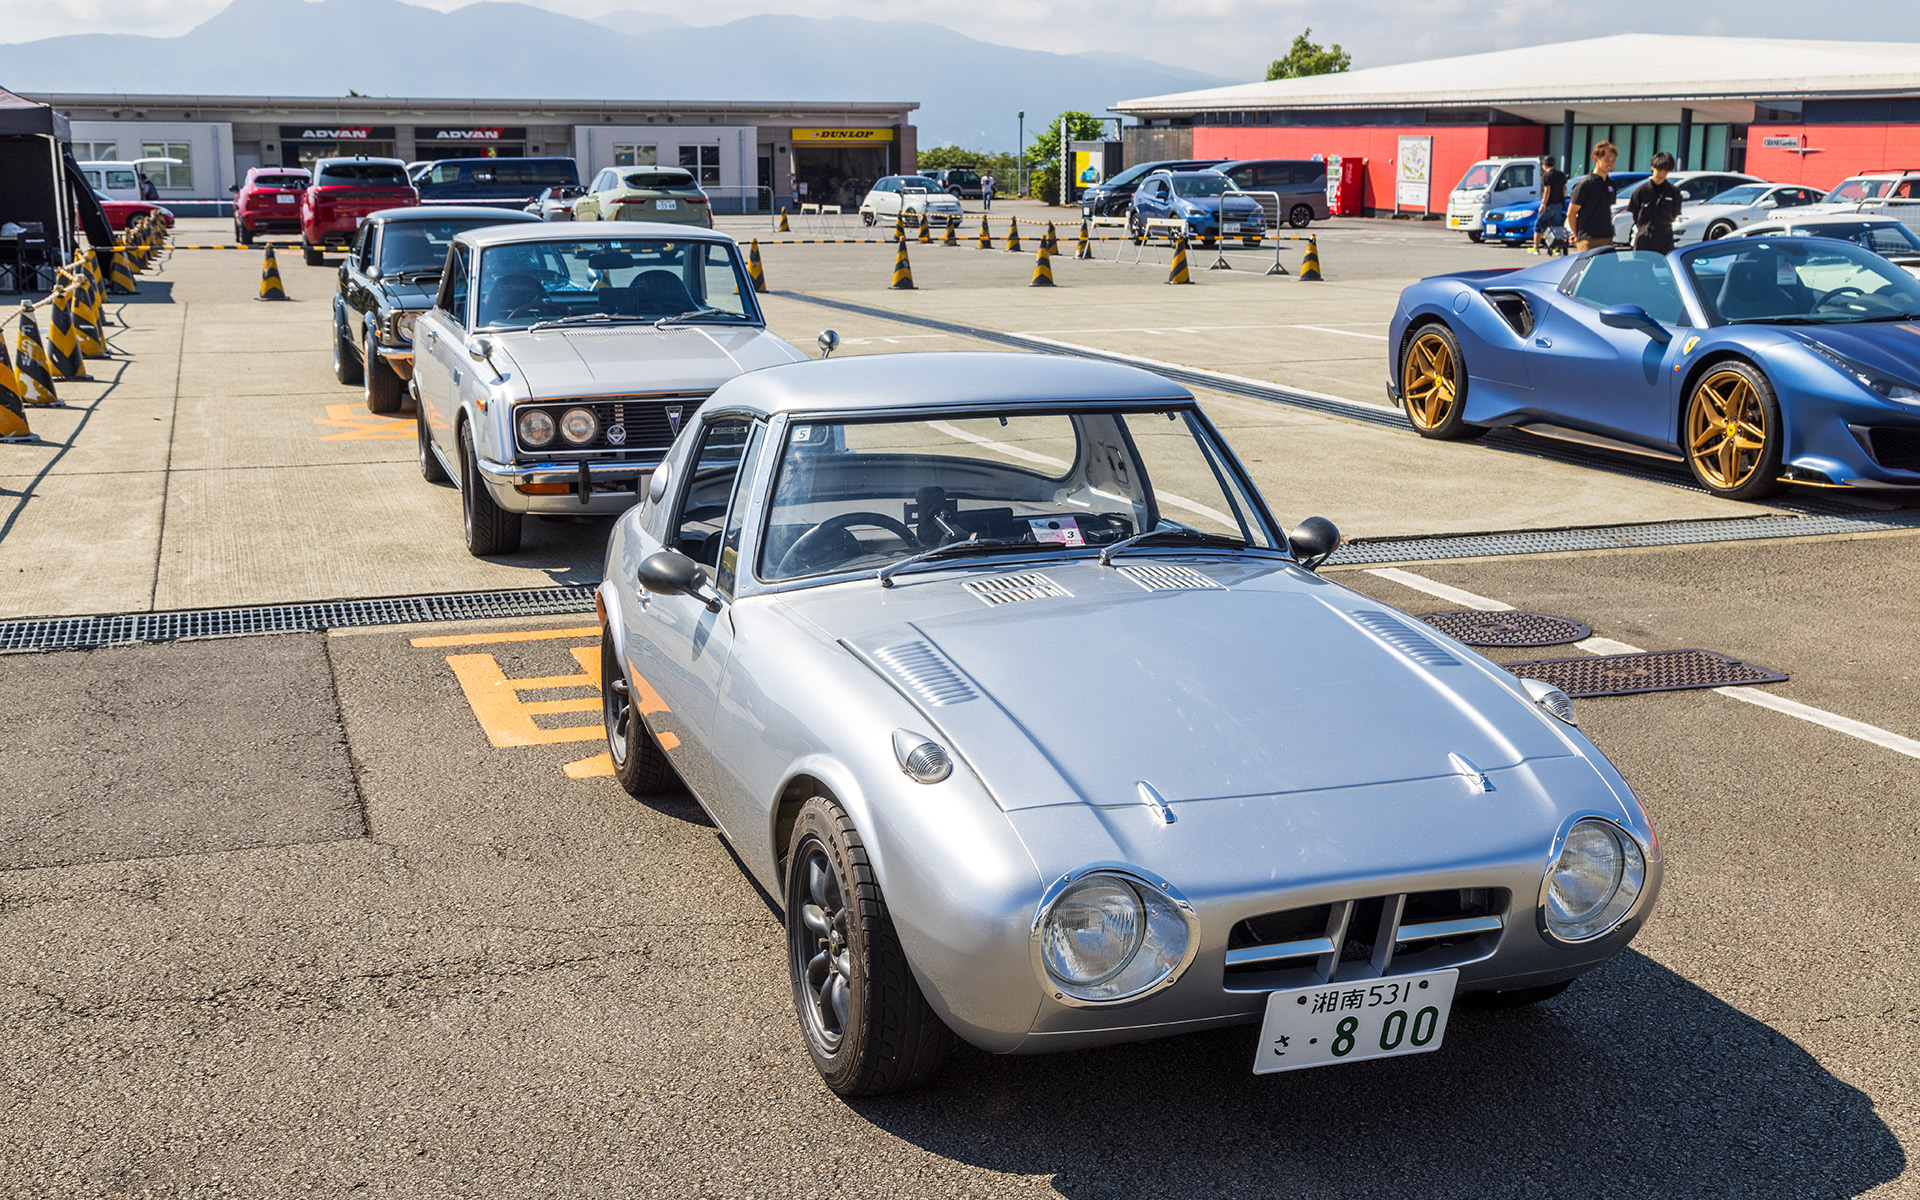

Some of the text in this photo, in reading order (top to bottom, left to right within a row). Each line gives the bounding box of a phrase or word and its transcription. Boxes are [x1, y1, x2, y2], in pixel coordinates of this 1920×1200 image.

[302, 129, 367, 139] ADVAN
[436, 130, 499, 139] ADVAN
[820, 130, 874, 138] DUNLOP
[799, 429, 806, 439] 5
[1067, 530, 1075, 539] 3
[1311, 981, 1411, 1014] 湘南531
[1274, 1034, 1291, 1056] さ
